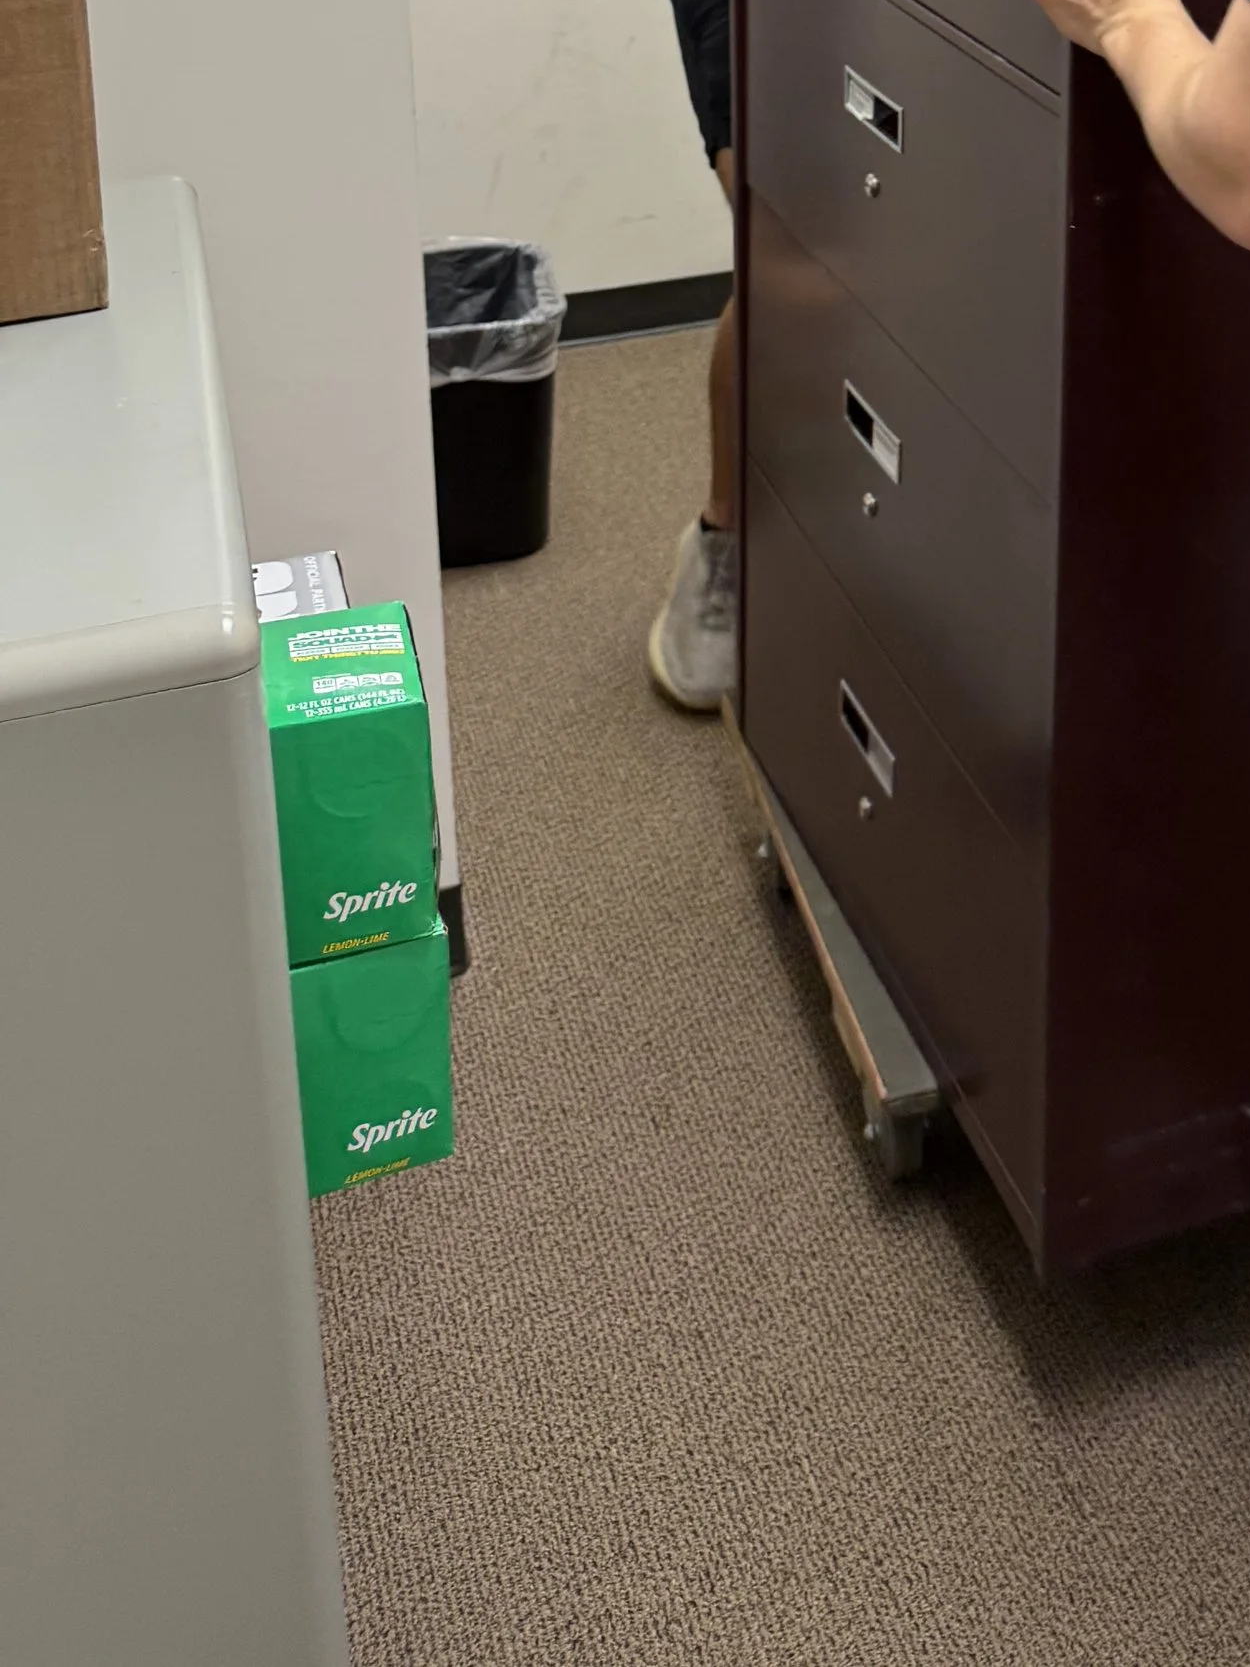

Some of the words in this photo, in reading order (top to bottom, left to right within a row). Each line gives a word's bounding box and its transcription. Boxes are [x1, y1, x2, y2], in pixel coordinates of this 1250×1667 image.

[303, 555, 321, 588] OFFICIAL
[287, 627, 350, 641] JOIN
[292, 634, 374, 649] SQUAD
[323, 879, 418, 923] Sprite
[322, 931, 390, 954] LEMON-LIME
[346, 1106, 438, 1153] Sprite
[344, 1156, 411, 1185] LEMON-LIME
